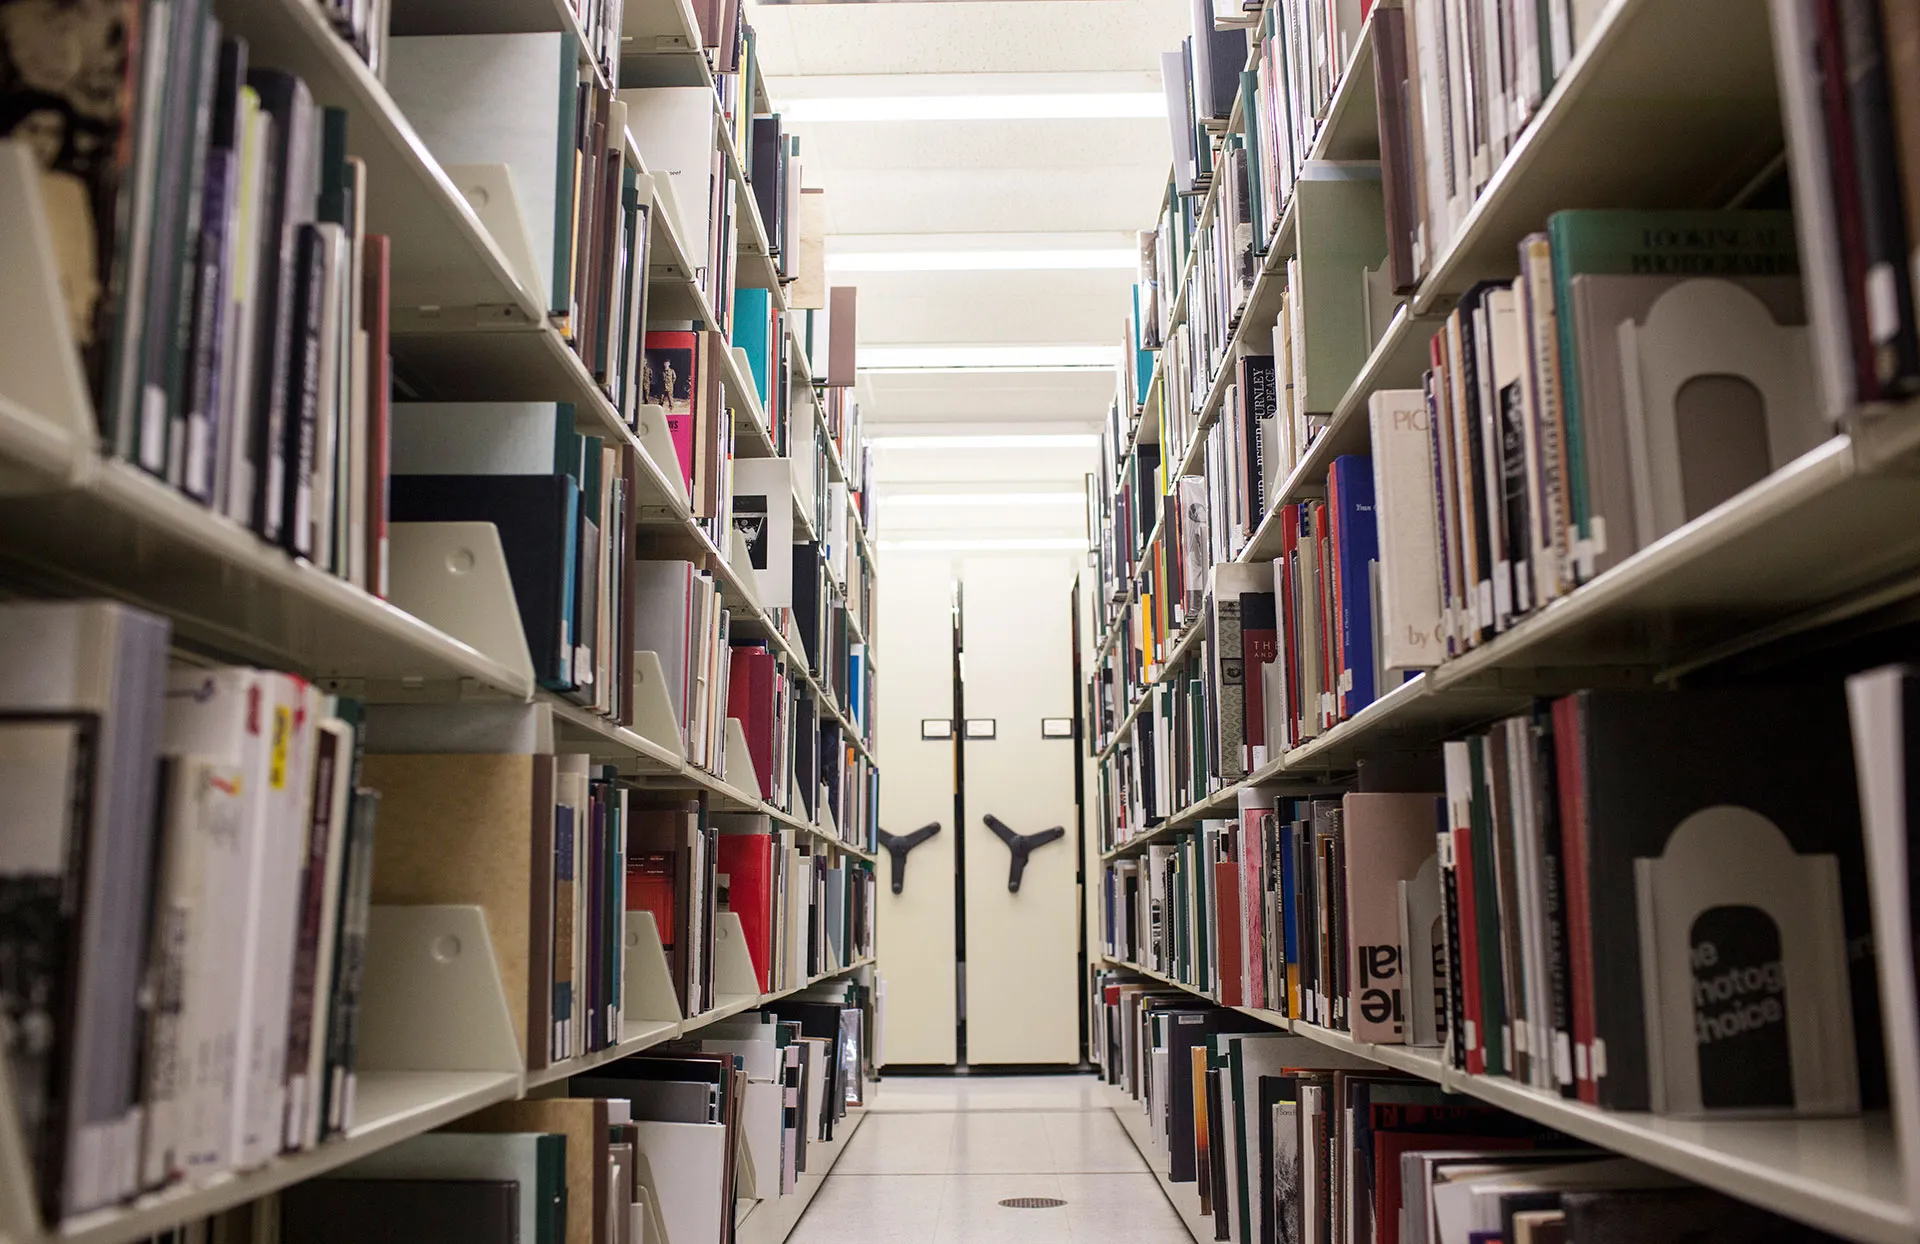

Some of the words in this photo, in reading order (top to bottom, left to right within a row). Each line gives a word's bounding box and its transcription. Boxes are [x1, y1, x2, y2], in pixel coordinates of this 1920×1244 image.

[1253, 367, 1266, 425] TURNLEY
[1265, 367, 1275, 402] PEACE
[1408, 624, 1430, 649] by
[1694, 961, 1783, 1006] hotog
[1695, 997, 1783, 1044] hoice
